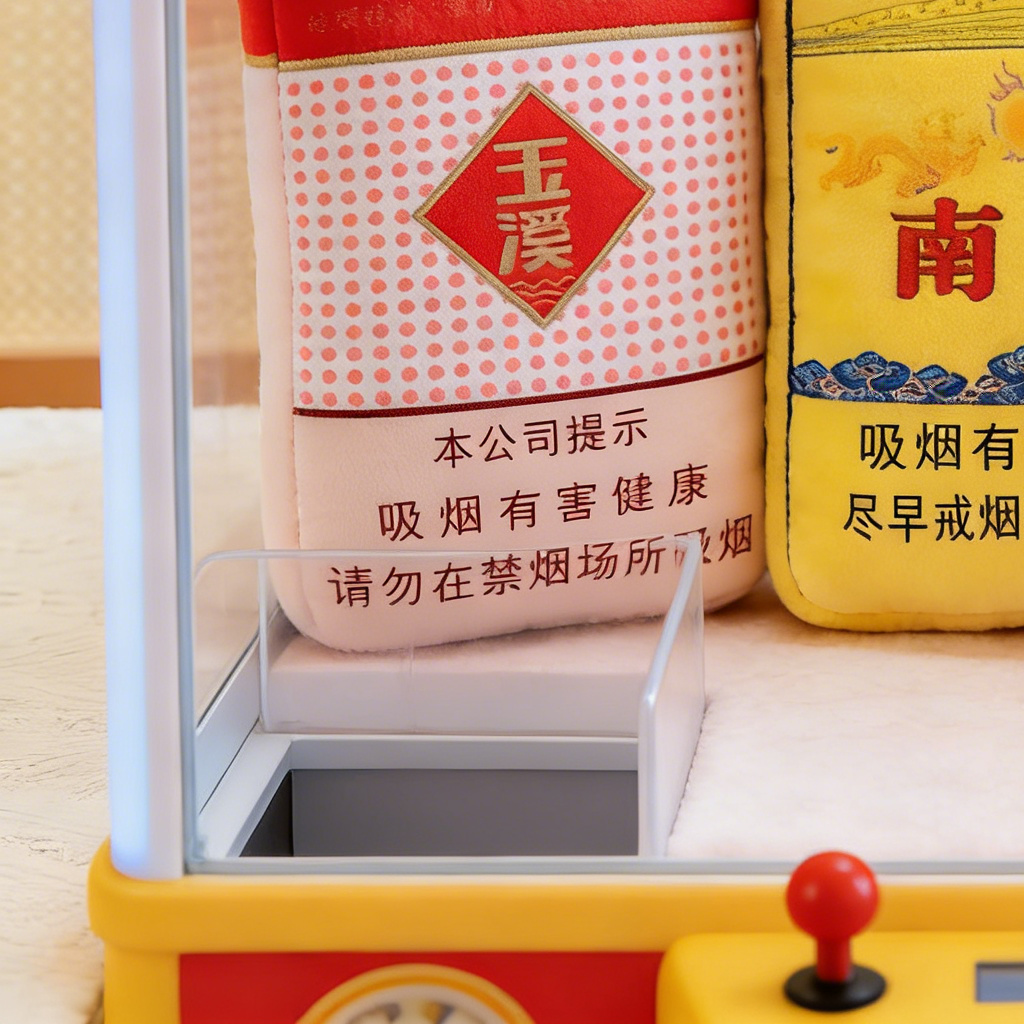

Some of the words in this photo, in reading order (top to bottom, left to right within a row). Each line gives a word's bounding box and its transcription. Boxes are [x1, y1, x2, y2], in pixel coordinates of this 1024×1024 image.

[493, 136, 574, 275] 玉溪
[433, 407, 649, 468] 本公司提示
[378, 463, 709, 541] 吸烟有害健康
